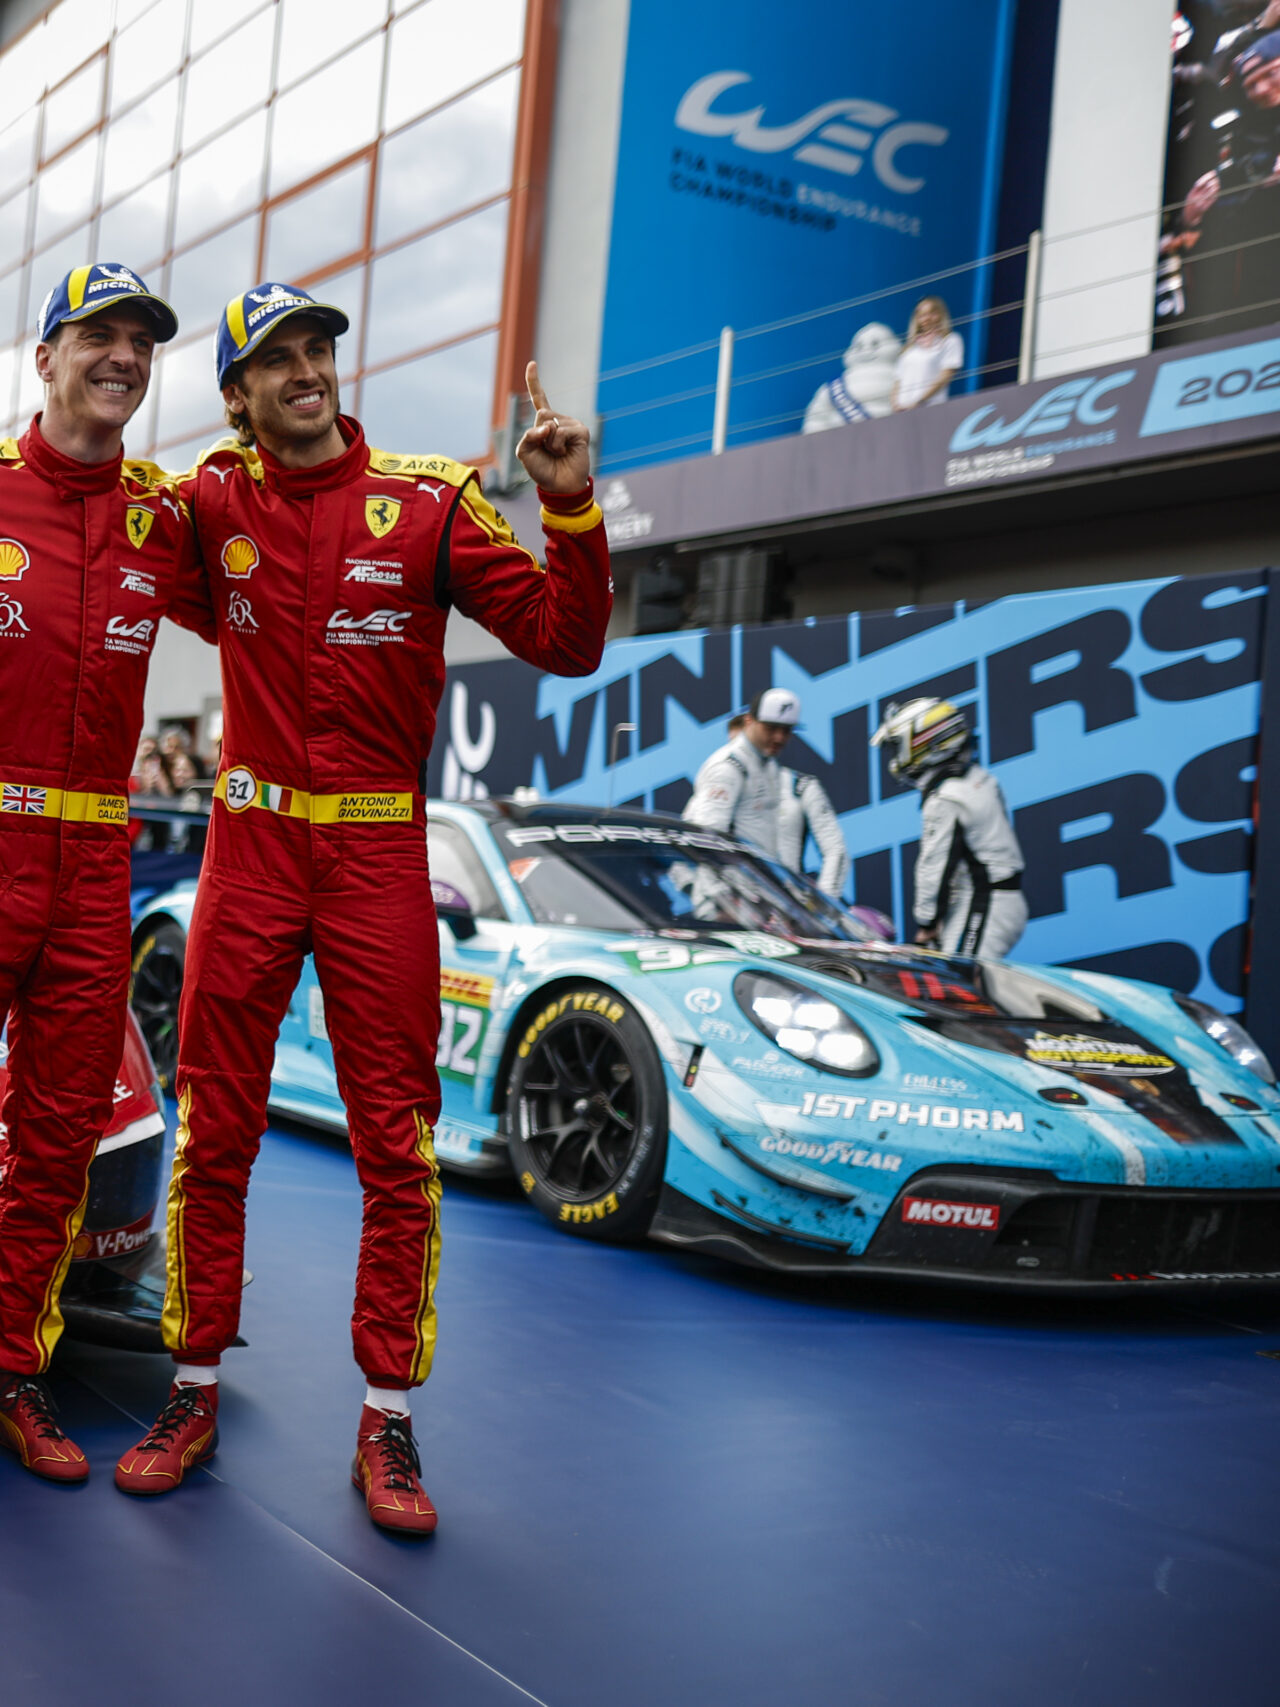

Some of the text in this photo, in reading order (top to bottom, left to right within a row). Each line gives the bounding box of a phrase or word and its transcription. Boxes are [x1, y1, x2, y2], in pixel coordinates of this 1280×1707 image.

[675, 69, 950, 194] WEC
[714, 160, 793, 199] WORLD
[949, 369, 1137, 453] WEC
[404, 460, 451, 473] AT&T
[345, 558, 403, 569] RACING PARTNER
[327, 608, 413, 632] WEC
[325, 638, 380, 646] CHAMPIONSHIP
[228, 778, 249, 800] 51
[338, 796, 397, 807] ANTONIO
[96, 797, 126, 809] JAMES
[338, 807, 410, 819] GIOVINAZZI
[518, 992, 625, 1058] GOODYEAR
[799, 1091, 1025, 1132] 1ST PHORM
[760, 1135, 903, 1172] GOODYEAR
[559, 1192, 619, 1223] EAGLE
[906, 1201, 995, 1227] MOTUL
